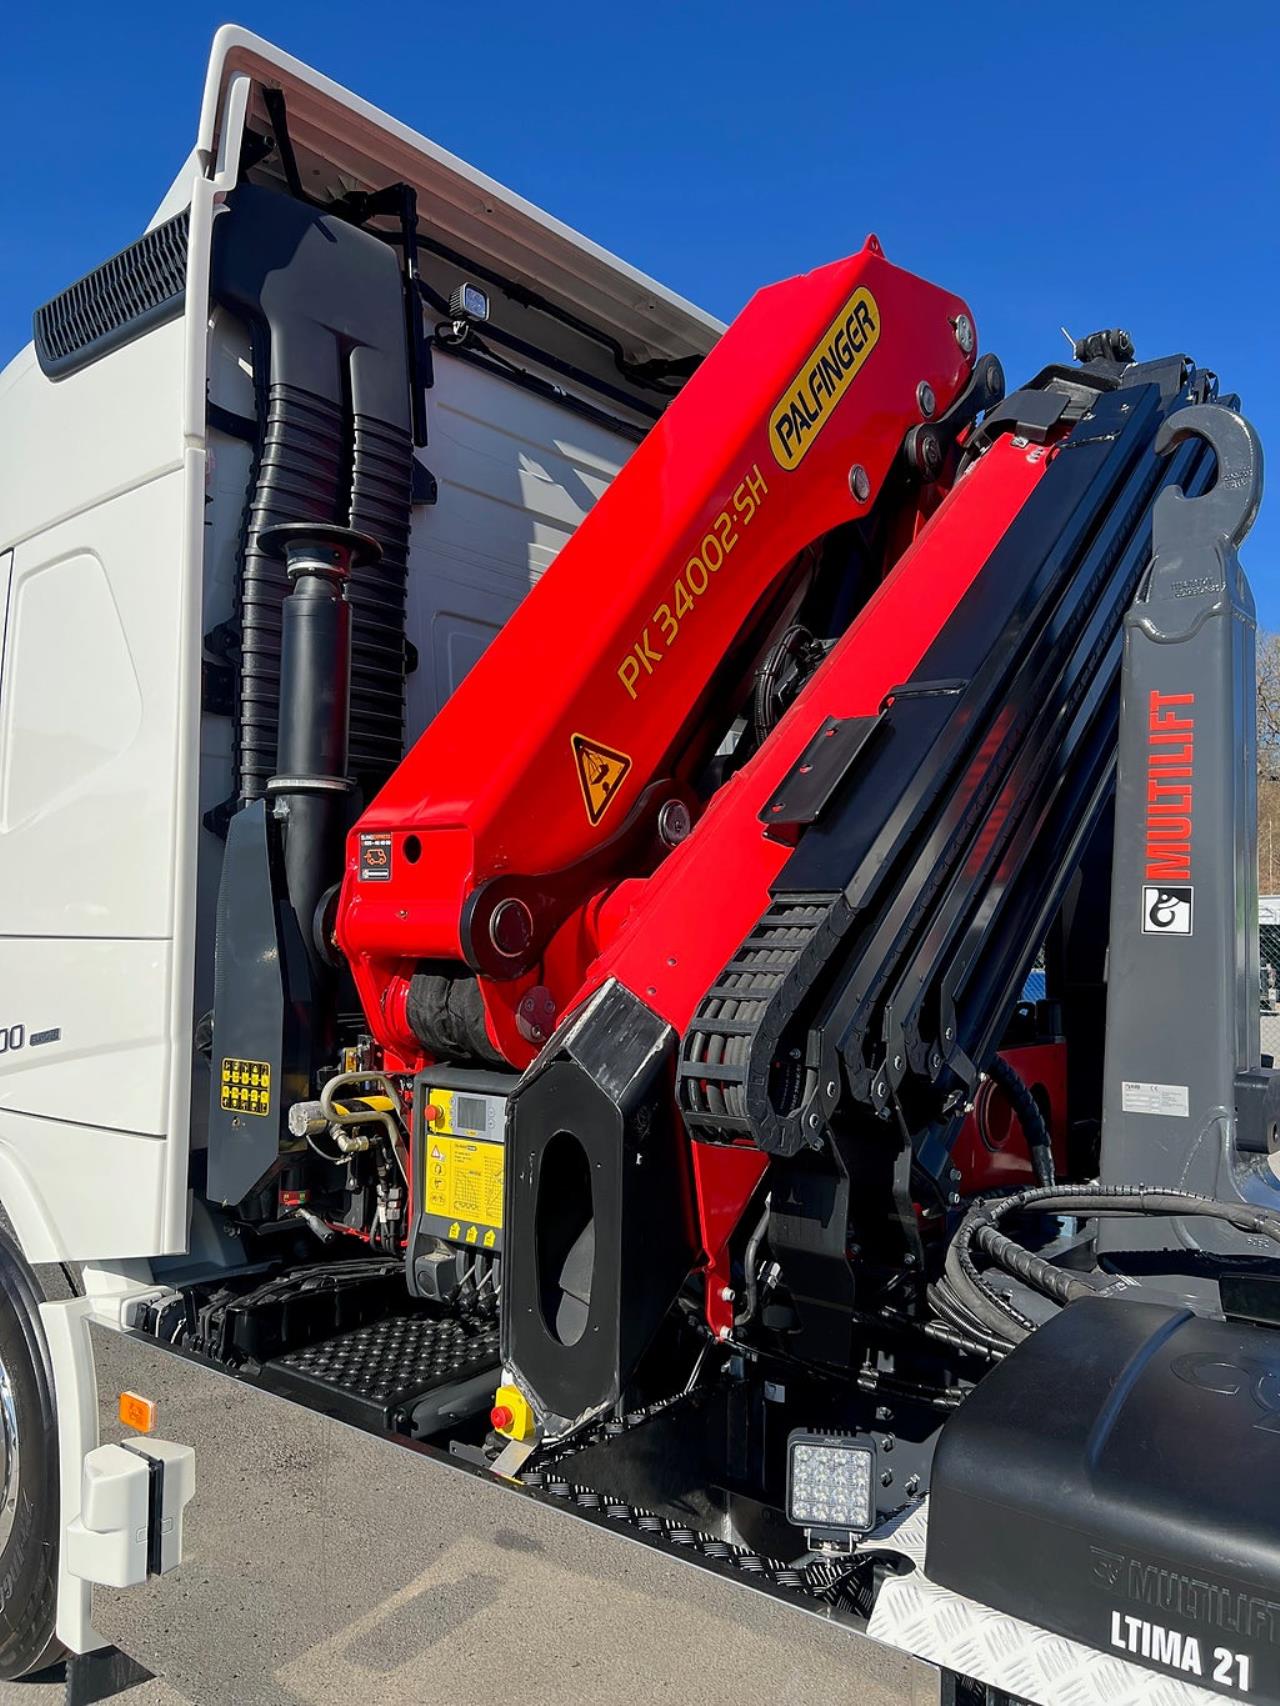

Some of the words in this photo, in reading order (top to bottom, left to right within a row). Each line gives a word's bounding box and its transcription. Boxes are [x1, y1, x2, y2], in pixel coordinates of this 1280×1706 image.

[774, 299, 876, 460] PALFINGER
[617, 628, 662, 700] PK
[1145, 690, 1195, 881] MULTILIFT
[1111, 1610, 1202, 1676] LTIMA
[1213, 1646, 1250, 1692] 21
